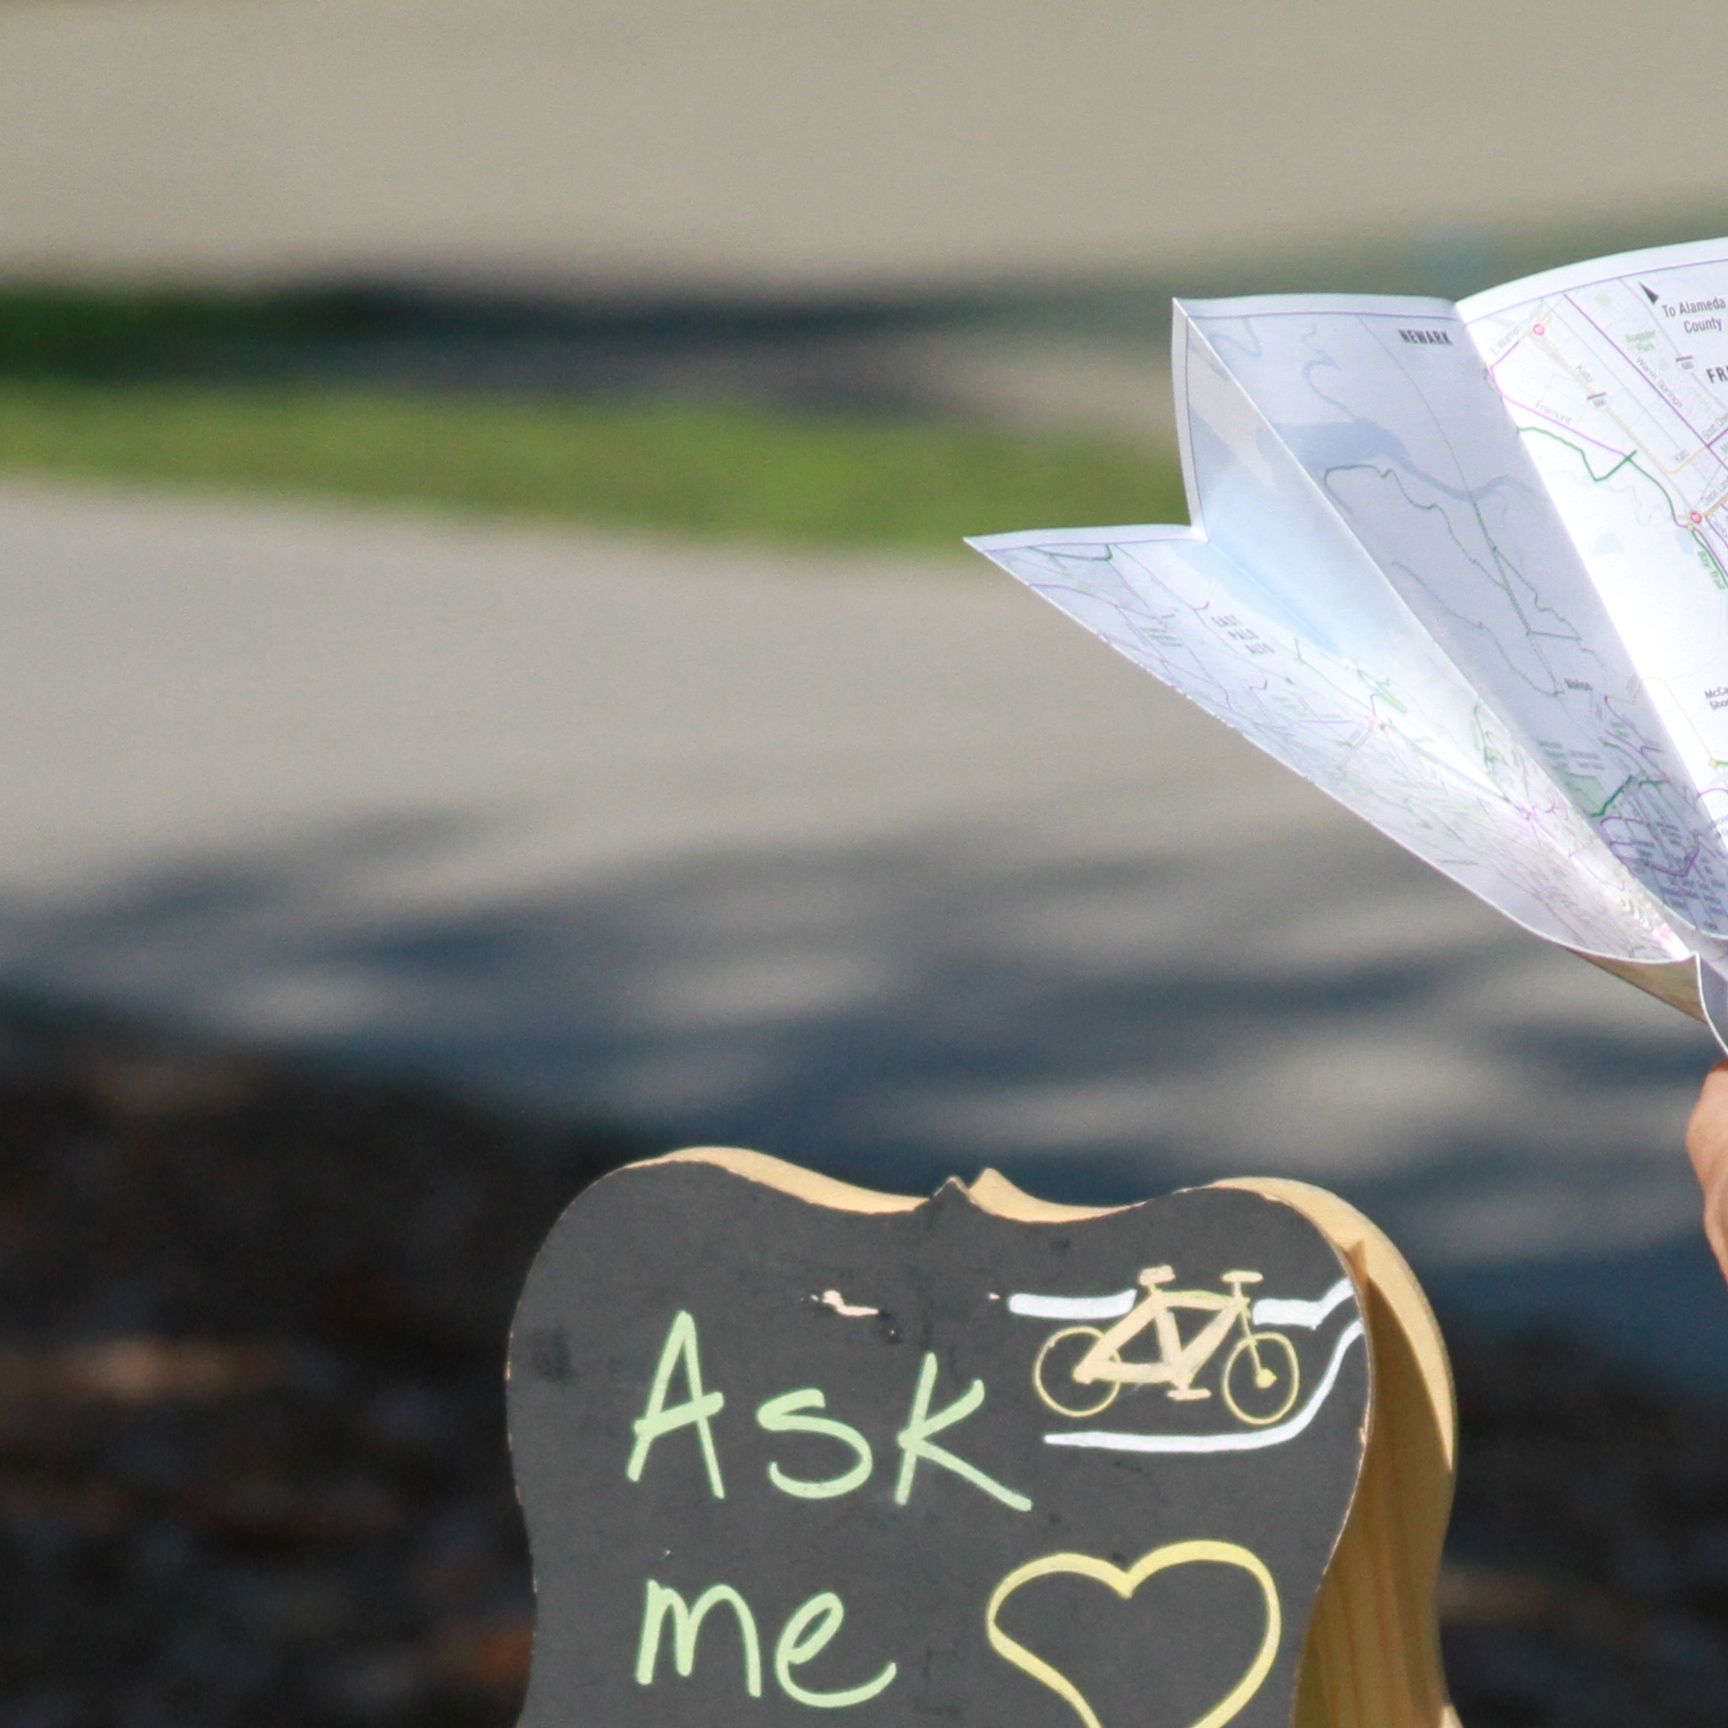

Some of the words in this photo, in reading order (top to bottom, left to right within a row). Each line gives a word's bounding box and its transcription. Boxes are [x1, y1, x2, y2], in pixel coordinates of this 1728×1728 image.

[1662, 304, 1676, 317] To
[1679, 297, 1726, 314] Alameda
[1684, 317, 1723, 333] County
[1398, 328, 1453, 346] NEWARK
[628, 1310, 1032, 1512] Ask
[635, 1580, 898, 1710] me
